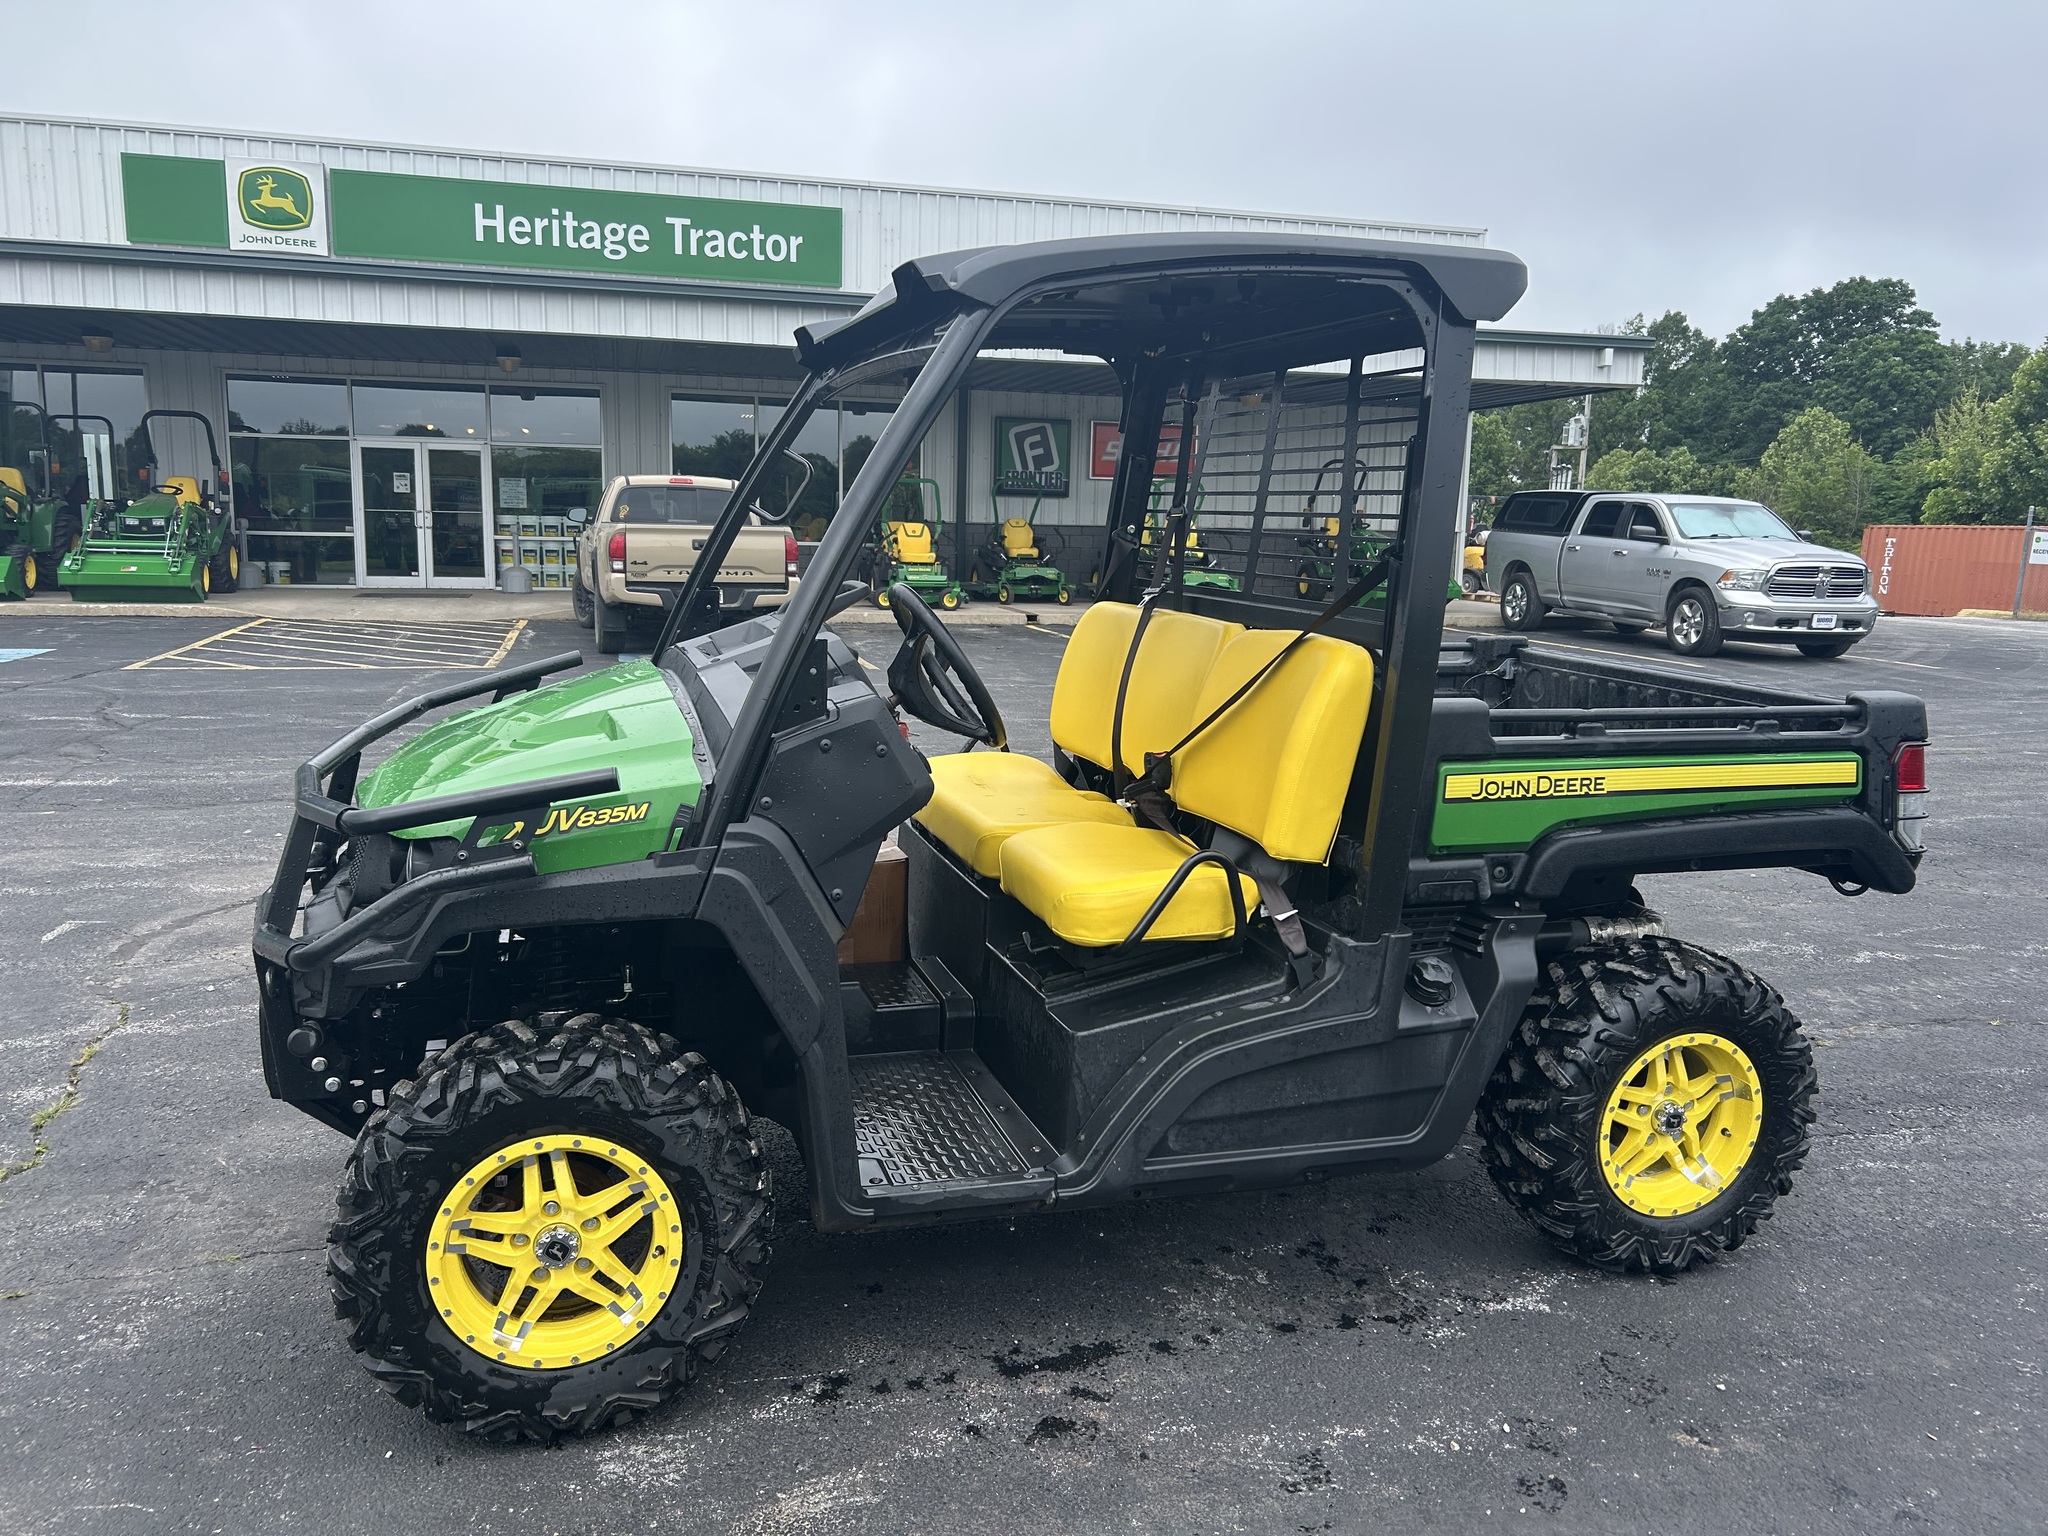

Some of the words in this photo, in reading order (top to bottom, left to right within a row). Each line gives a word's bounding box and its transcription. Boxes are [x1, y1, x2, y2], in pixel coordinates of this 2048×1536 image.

[239, 233, 273, 245] JOHN
[275, 235, 317, 248] DEERE
[474, 202, 650, 260] Heritage
[665, 217, 803, 263] Tractor
[1004, 470, 1063, 489] FRONTIER
[1877, 537, 1897, 595] TRITON
[1471, 778, 1531, 798] JOHN
[1537, 775, 1606, 795] DEERE
